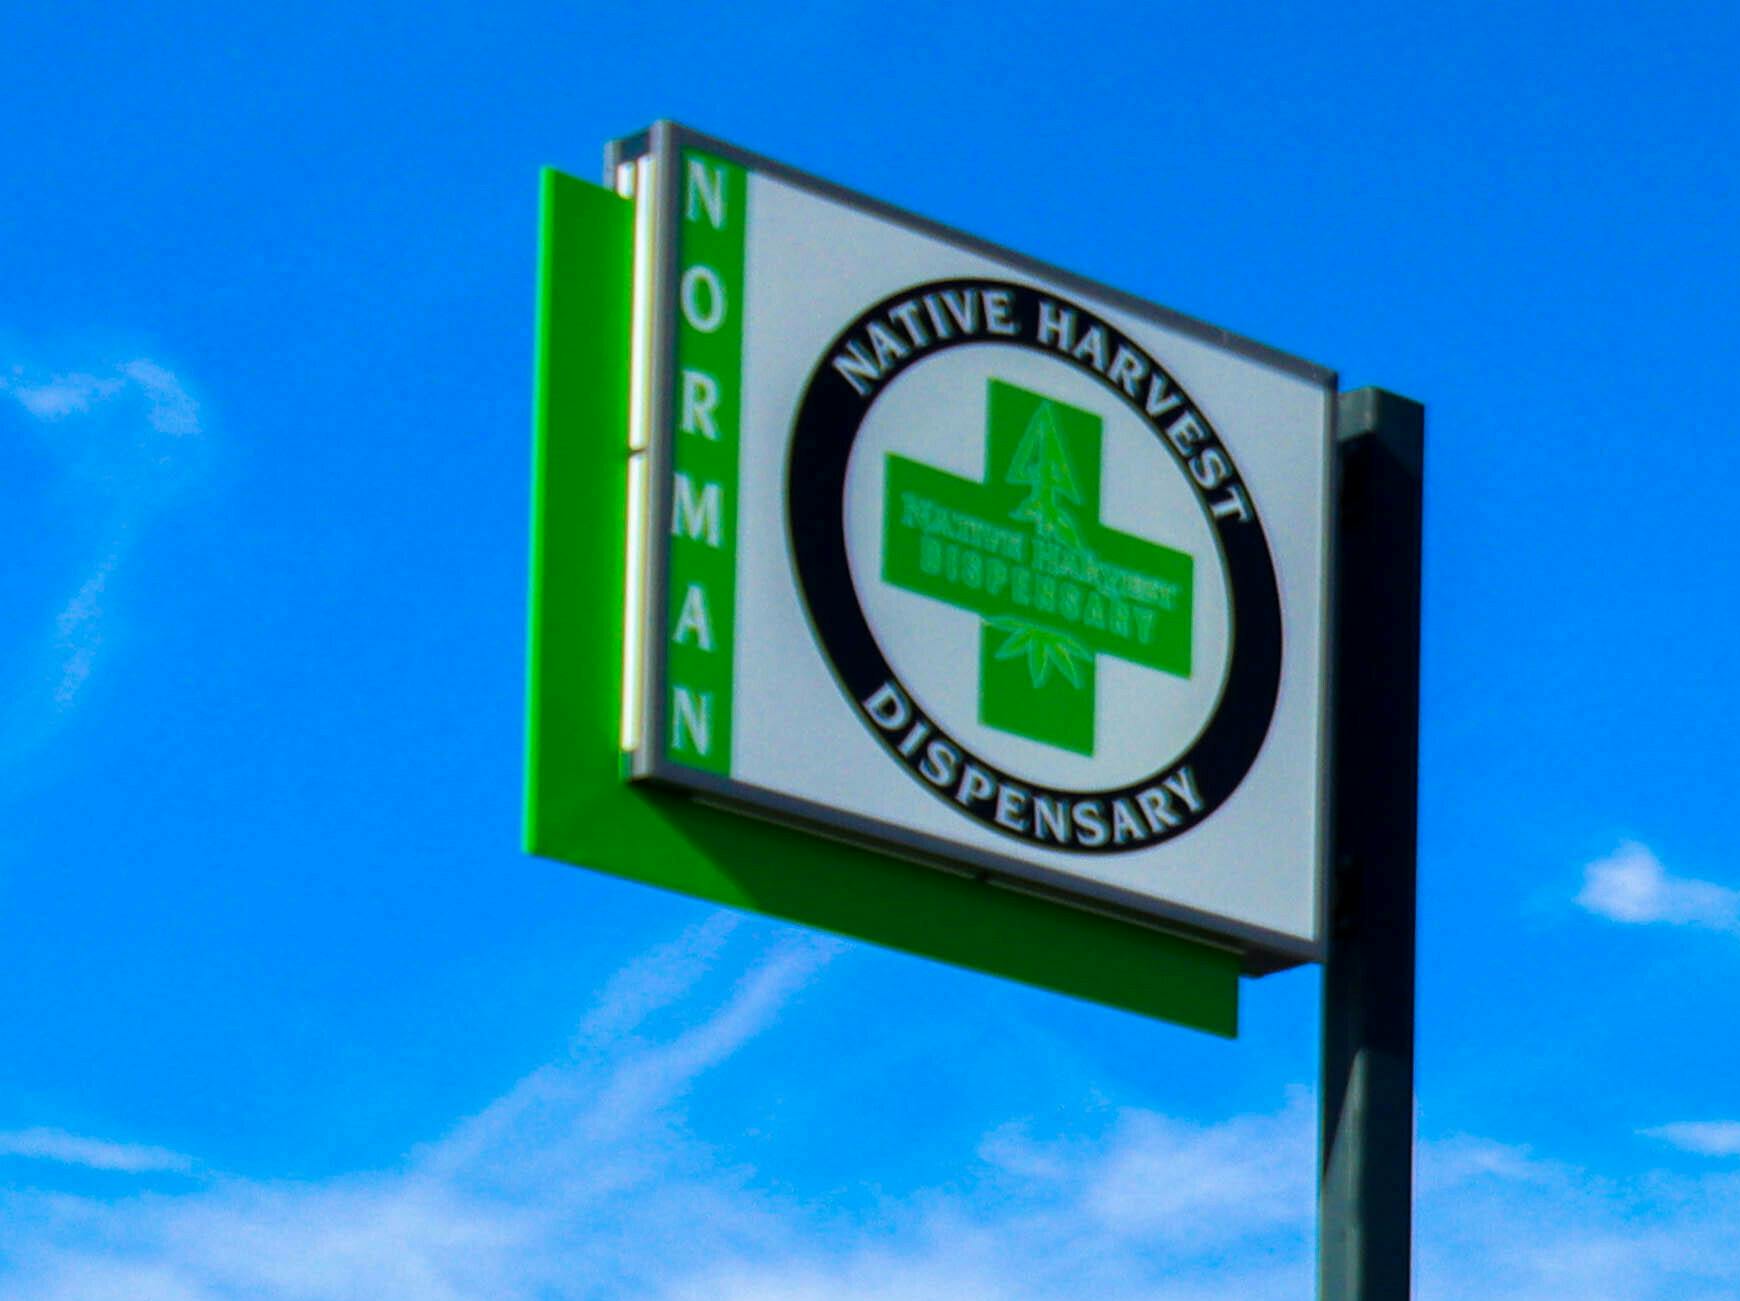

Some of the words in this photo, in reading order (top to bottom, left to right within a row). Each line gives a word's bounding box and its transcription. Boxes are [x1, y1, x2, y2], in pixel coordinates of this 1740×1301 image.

[671, 155, 728, 757] NORMAN
[831, 287, 1021, 398] NATIVE
[1037, 300, 1251, 524] HARVEST
[861, 680, 1206, 847] DISPENSARY
